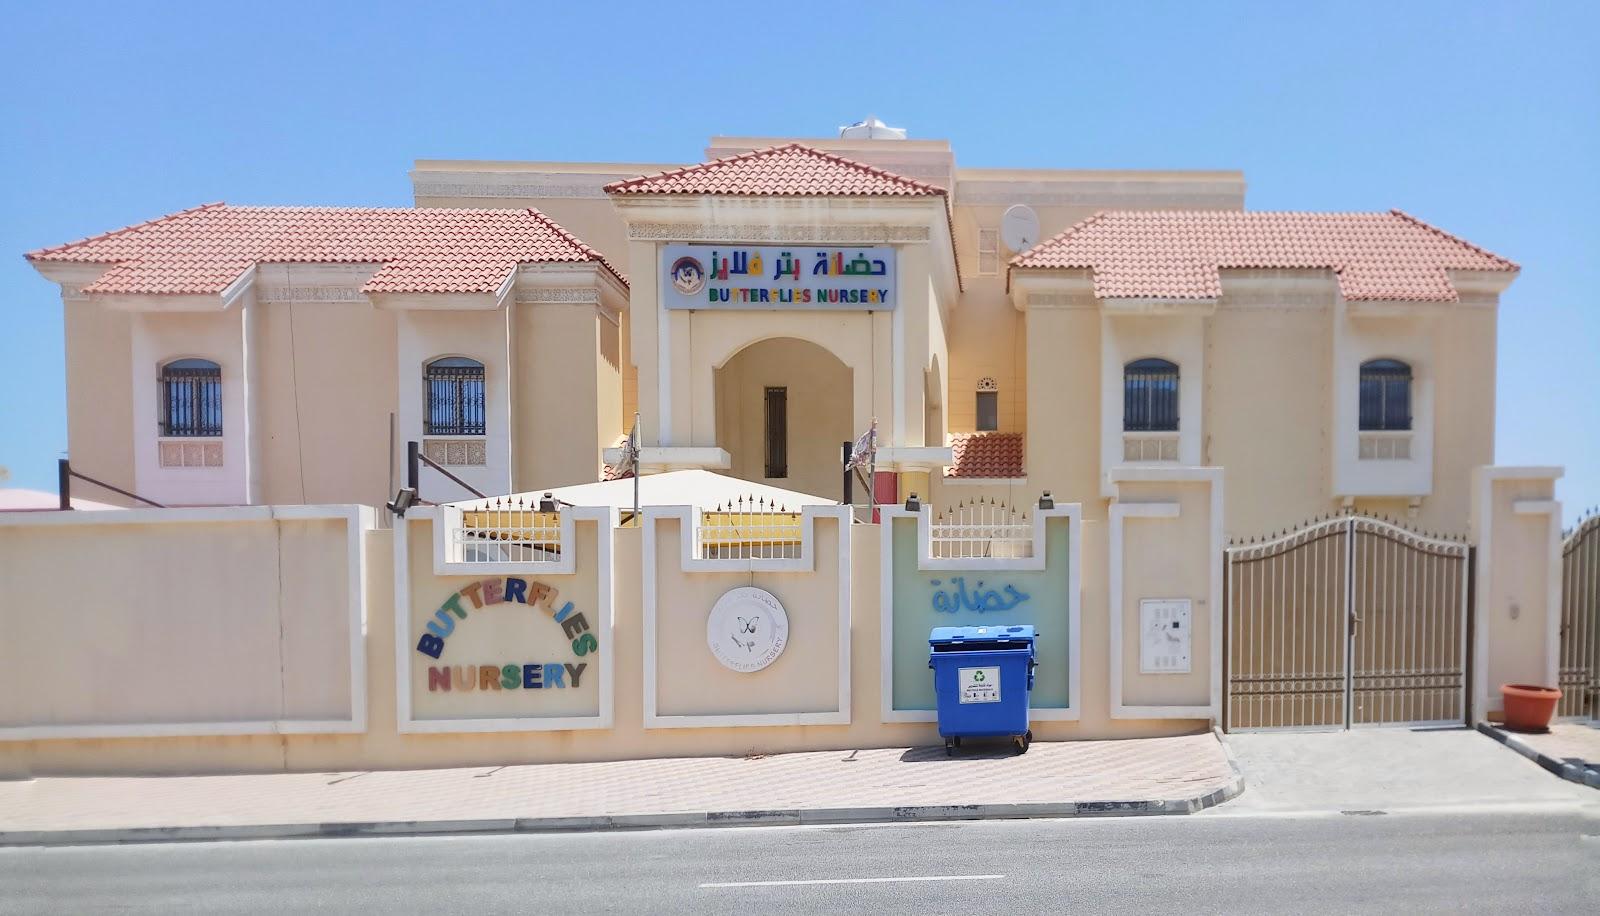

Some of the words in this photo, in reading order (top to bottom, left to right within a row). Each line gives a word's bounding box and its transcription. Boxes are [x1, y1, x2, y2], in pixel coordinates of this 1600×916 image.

[709, 251, 763, 280] فلايز
[773, 252, 801, 281] بتر
[813, 251, 886, 277] حضانة
[709, 288, 811, 303] BUTTERFLIES
[817, 288, 888, 303] NURSERY
[930, 576, 1031, 614] حضانة
[416, 577, 598, 659] BUTTERFLIES
[757, 636, 783, 667] NURSERY
[428, 663, 588, 692] NURSERY
